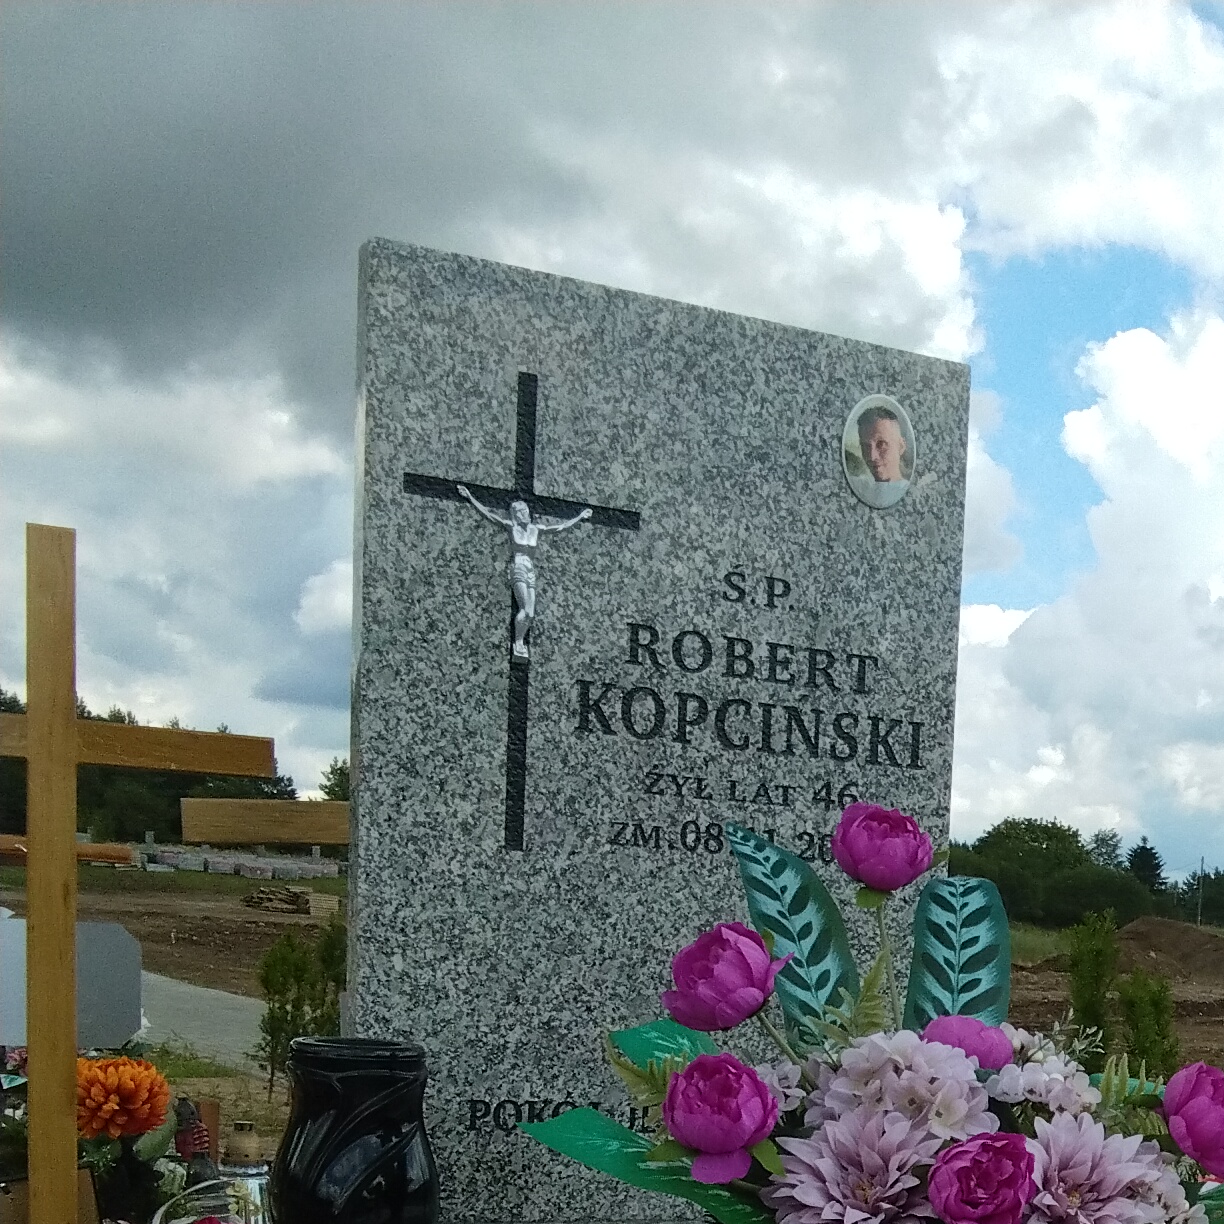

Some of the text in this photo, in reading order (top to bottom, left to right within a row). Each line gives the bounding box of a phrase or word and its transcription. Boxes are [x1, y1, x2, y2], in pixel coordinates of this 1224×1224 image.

[625, 622, 879, 695] ROBERT
[728, 779, 802, 807] LAT
[812, 781, 856, 811] 46
